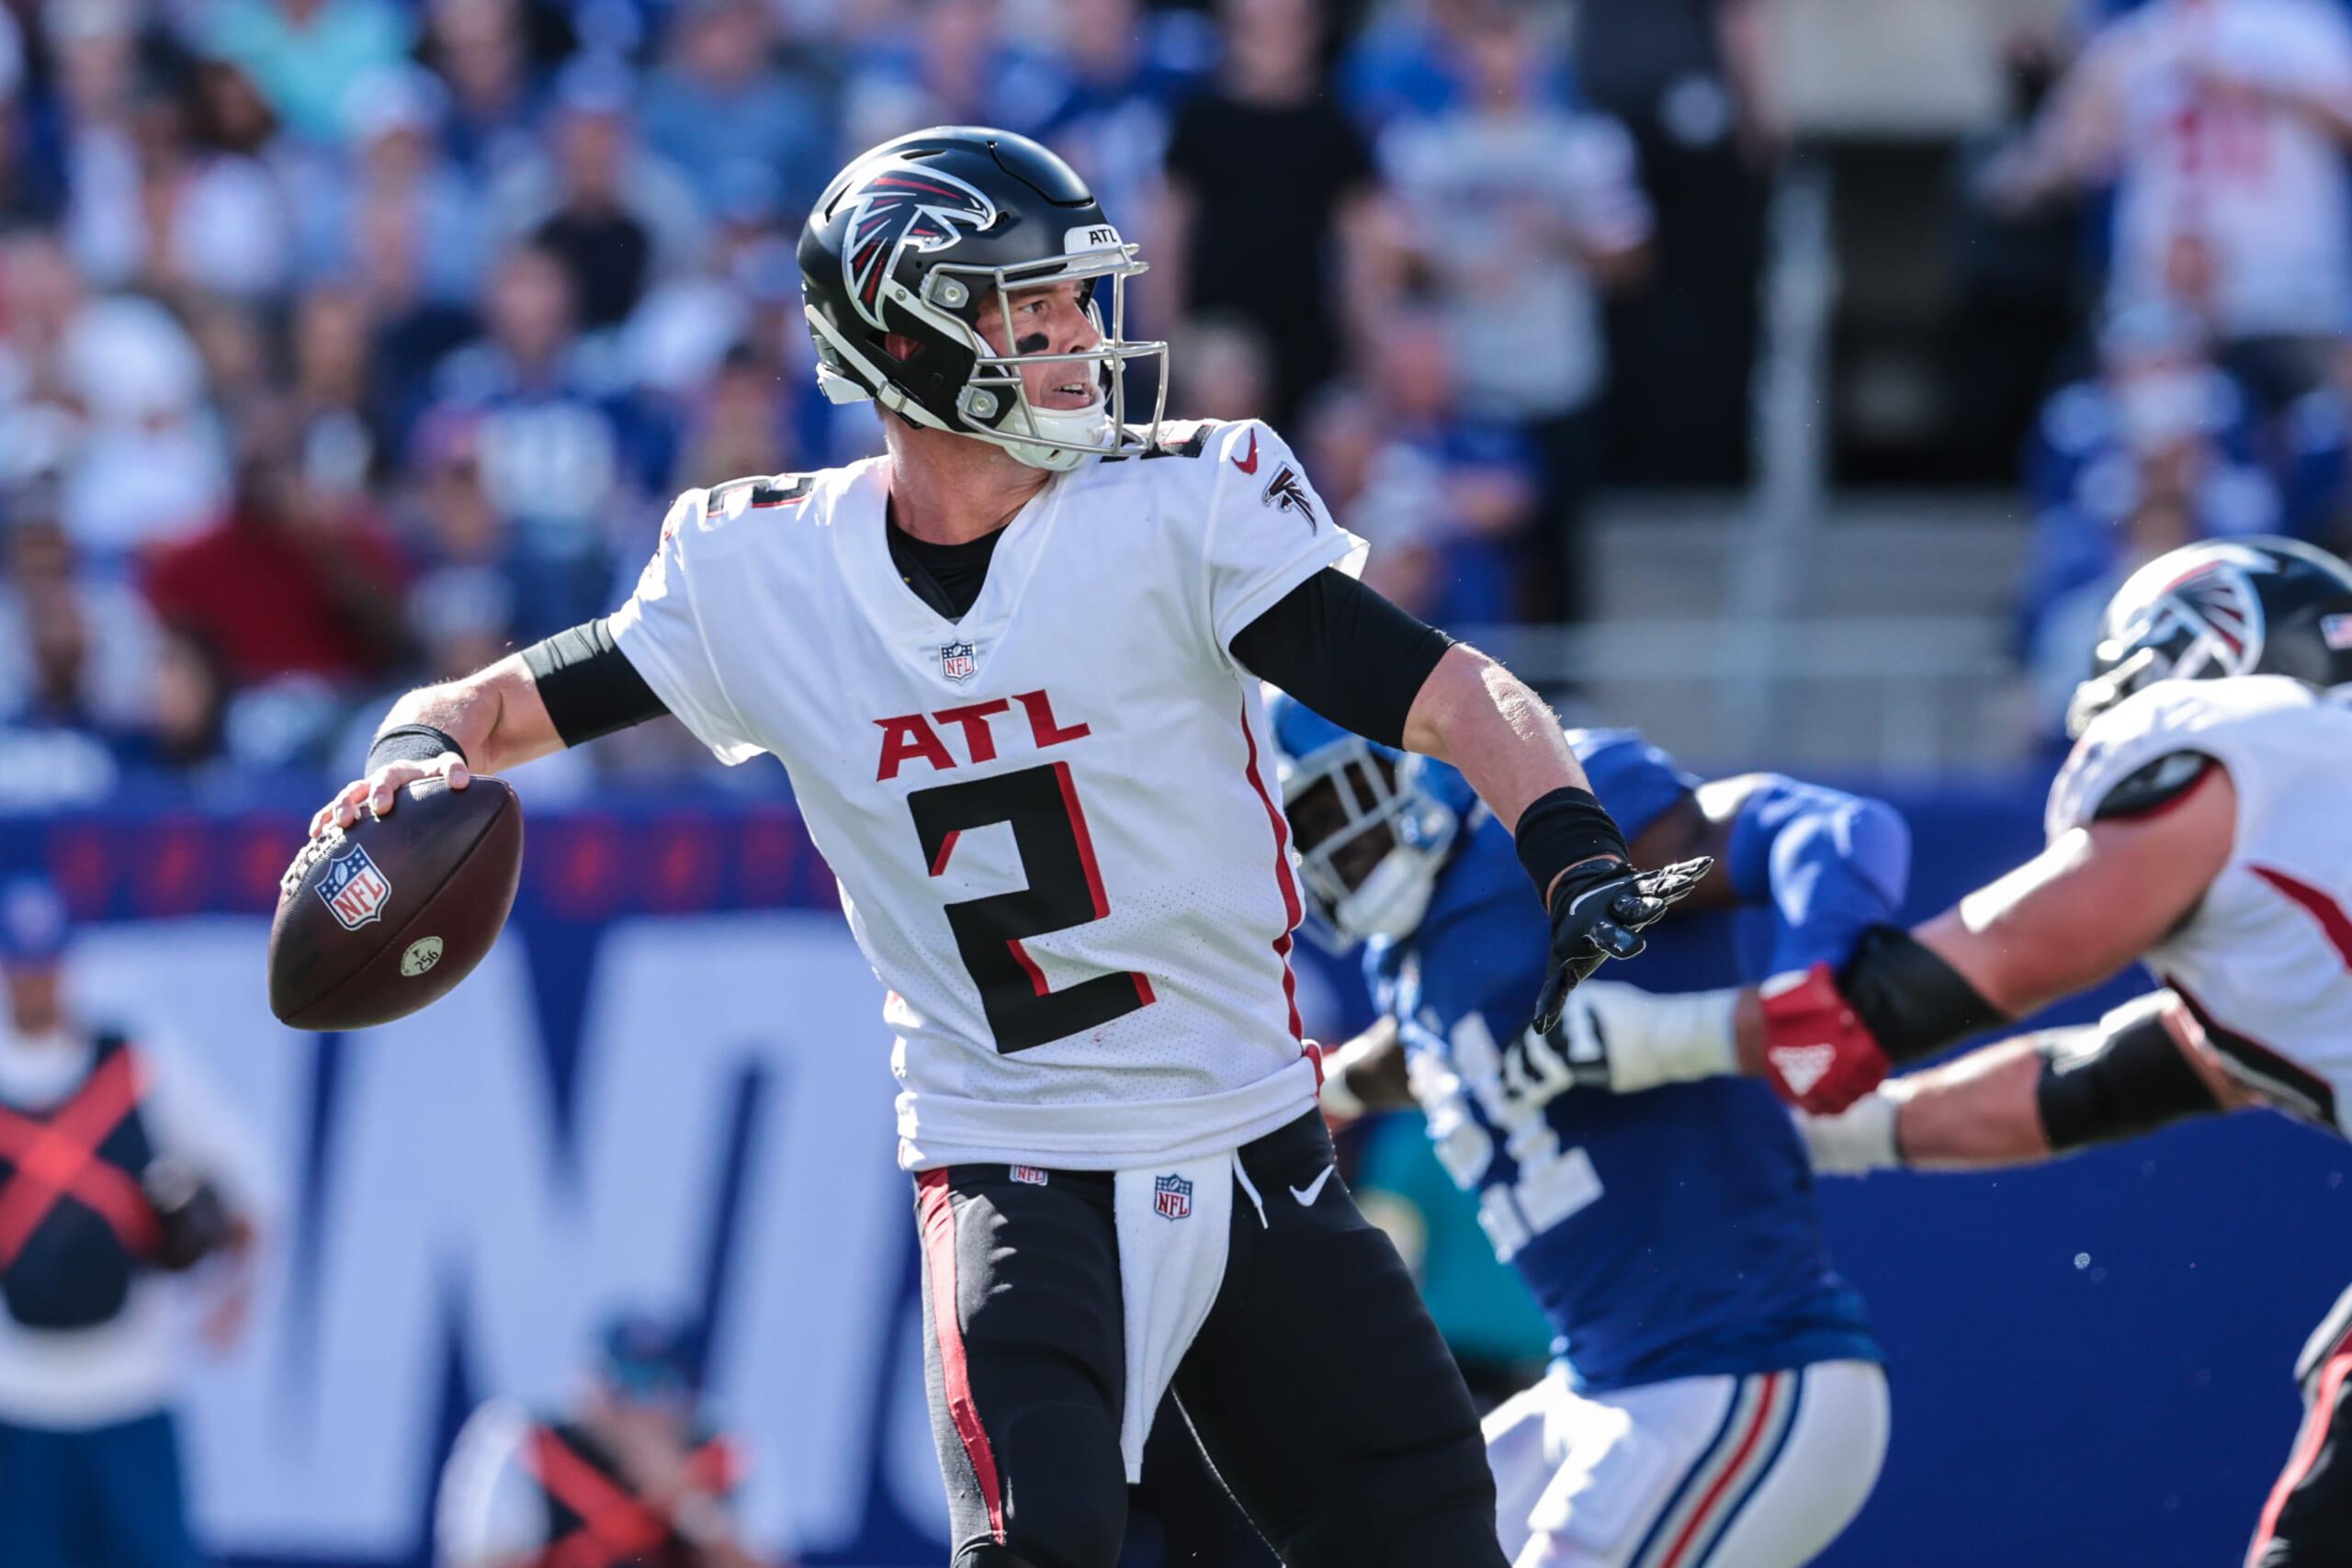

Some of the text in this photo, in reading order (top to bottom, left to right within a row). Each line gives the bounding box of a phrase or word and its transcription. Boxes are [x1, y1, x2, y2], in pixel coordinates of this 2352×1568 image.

[1088, 229, 1117, 245] ATL
[946, 657, 972, 675] NFL
[873, 689, 1091, 782] ATL
[333, 872, 384, 923] NFL
[907, 761, 1157, 1055] 2
[413, 948, 439, 972] 256
[1017, 1165, 1043, 1182] NFL
[1158, 1191, 1189, 1216] NFL
